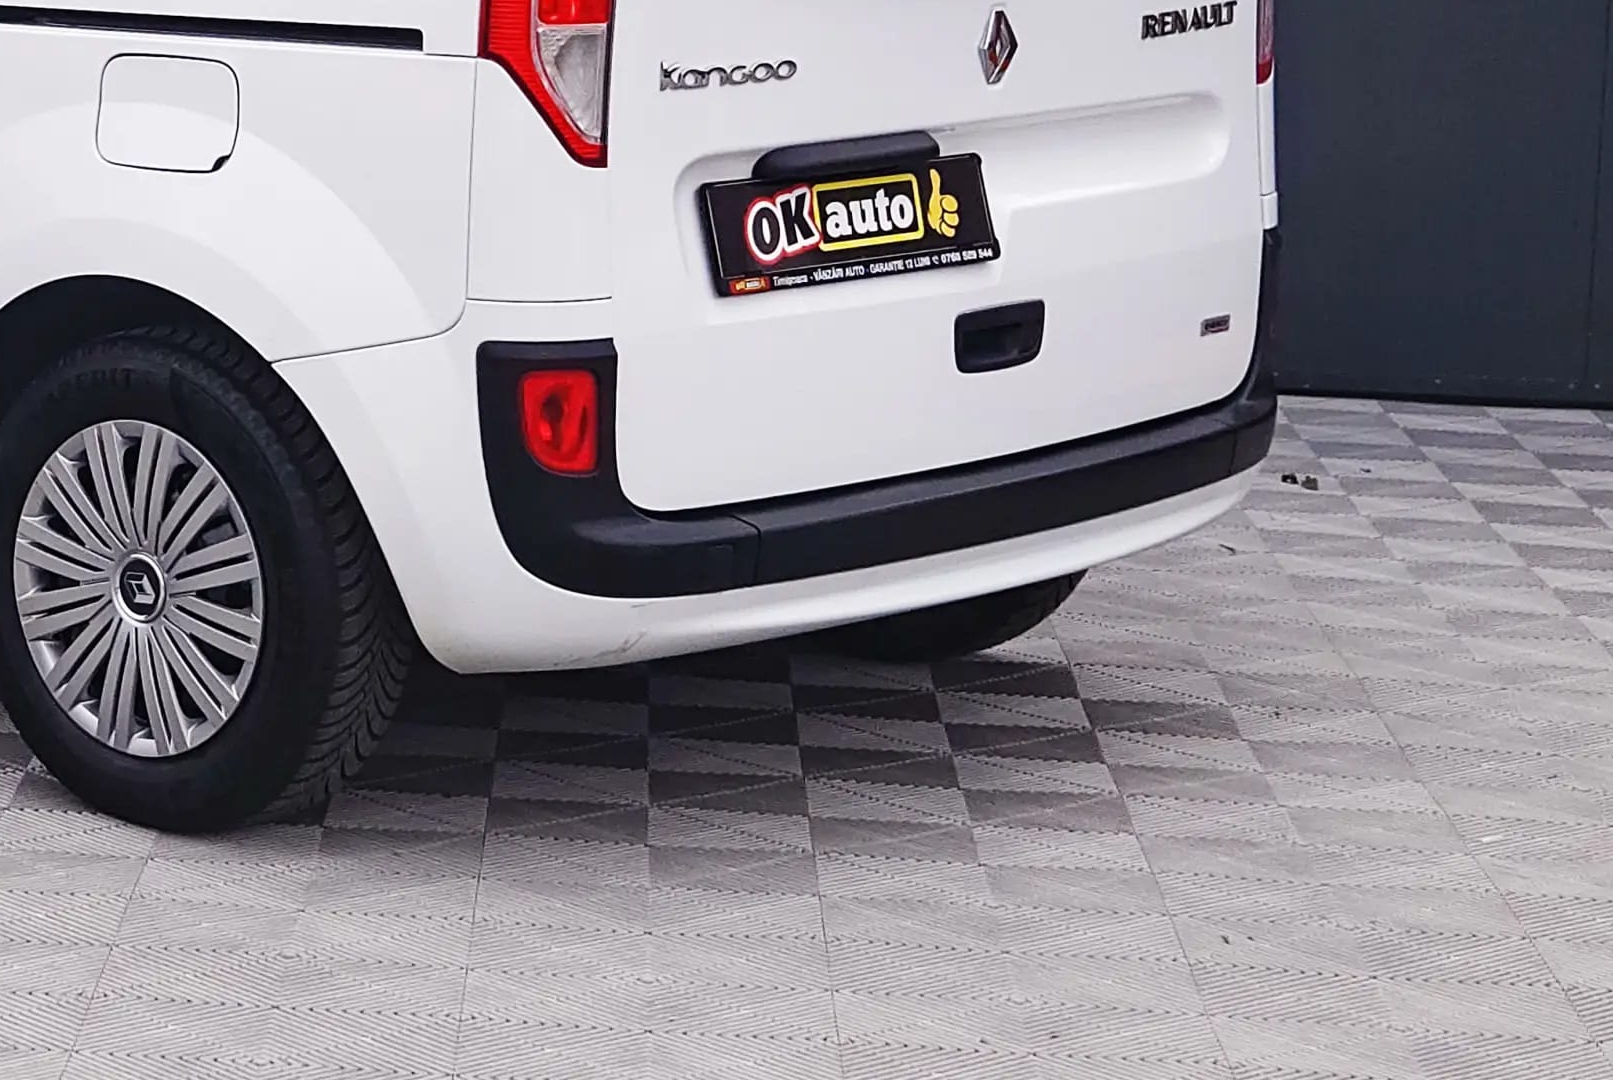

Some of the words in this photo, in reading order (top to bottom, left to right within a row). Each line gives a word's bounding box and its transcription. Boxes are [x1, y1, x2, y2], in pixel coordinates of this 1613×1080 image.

[1141, 0, 1238, 40] RENAULT
[747, 186, 821, 261] OK
[825, 188, 915, 238] auto
